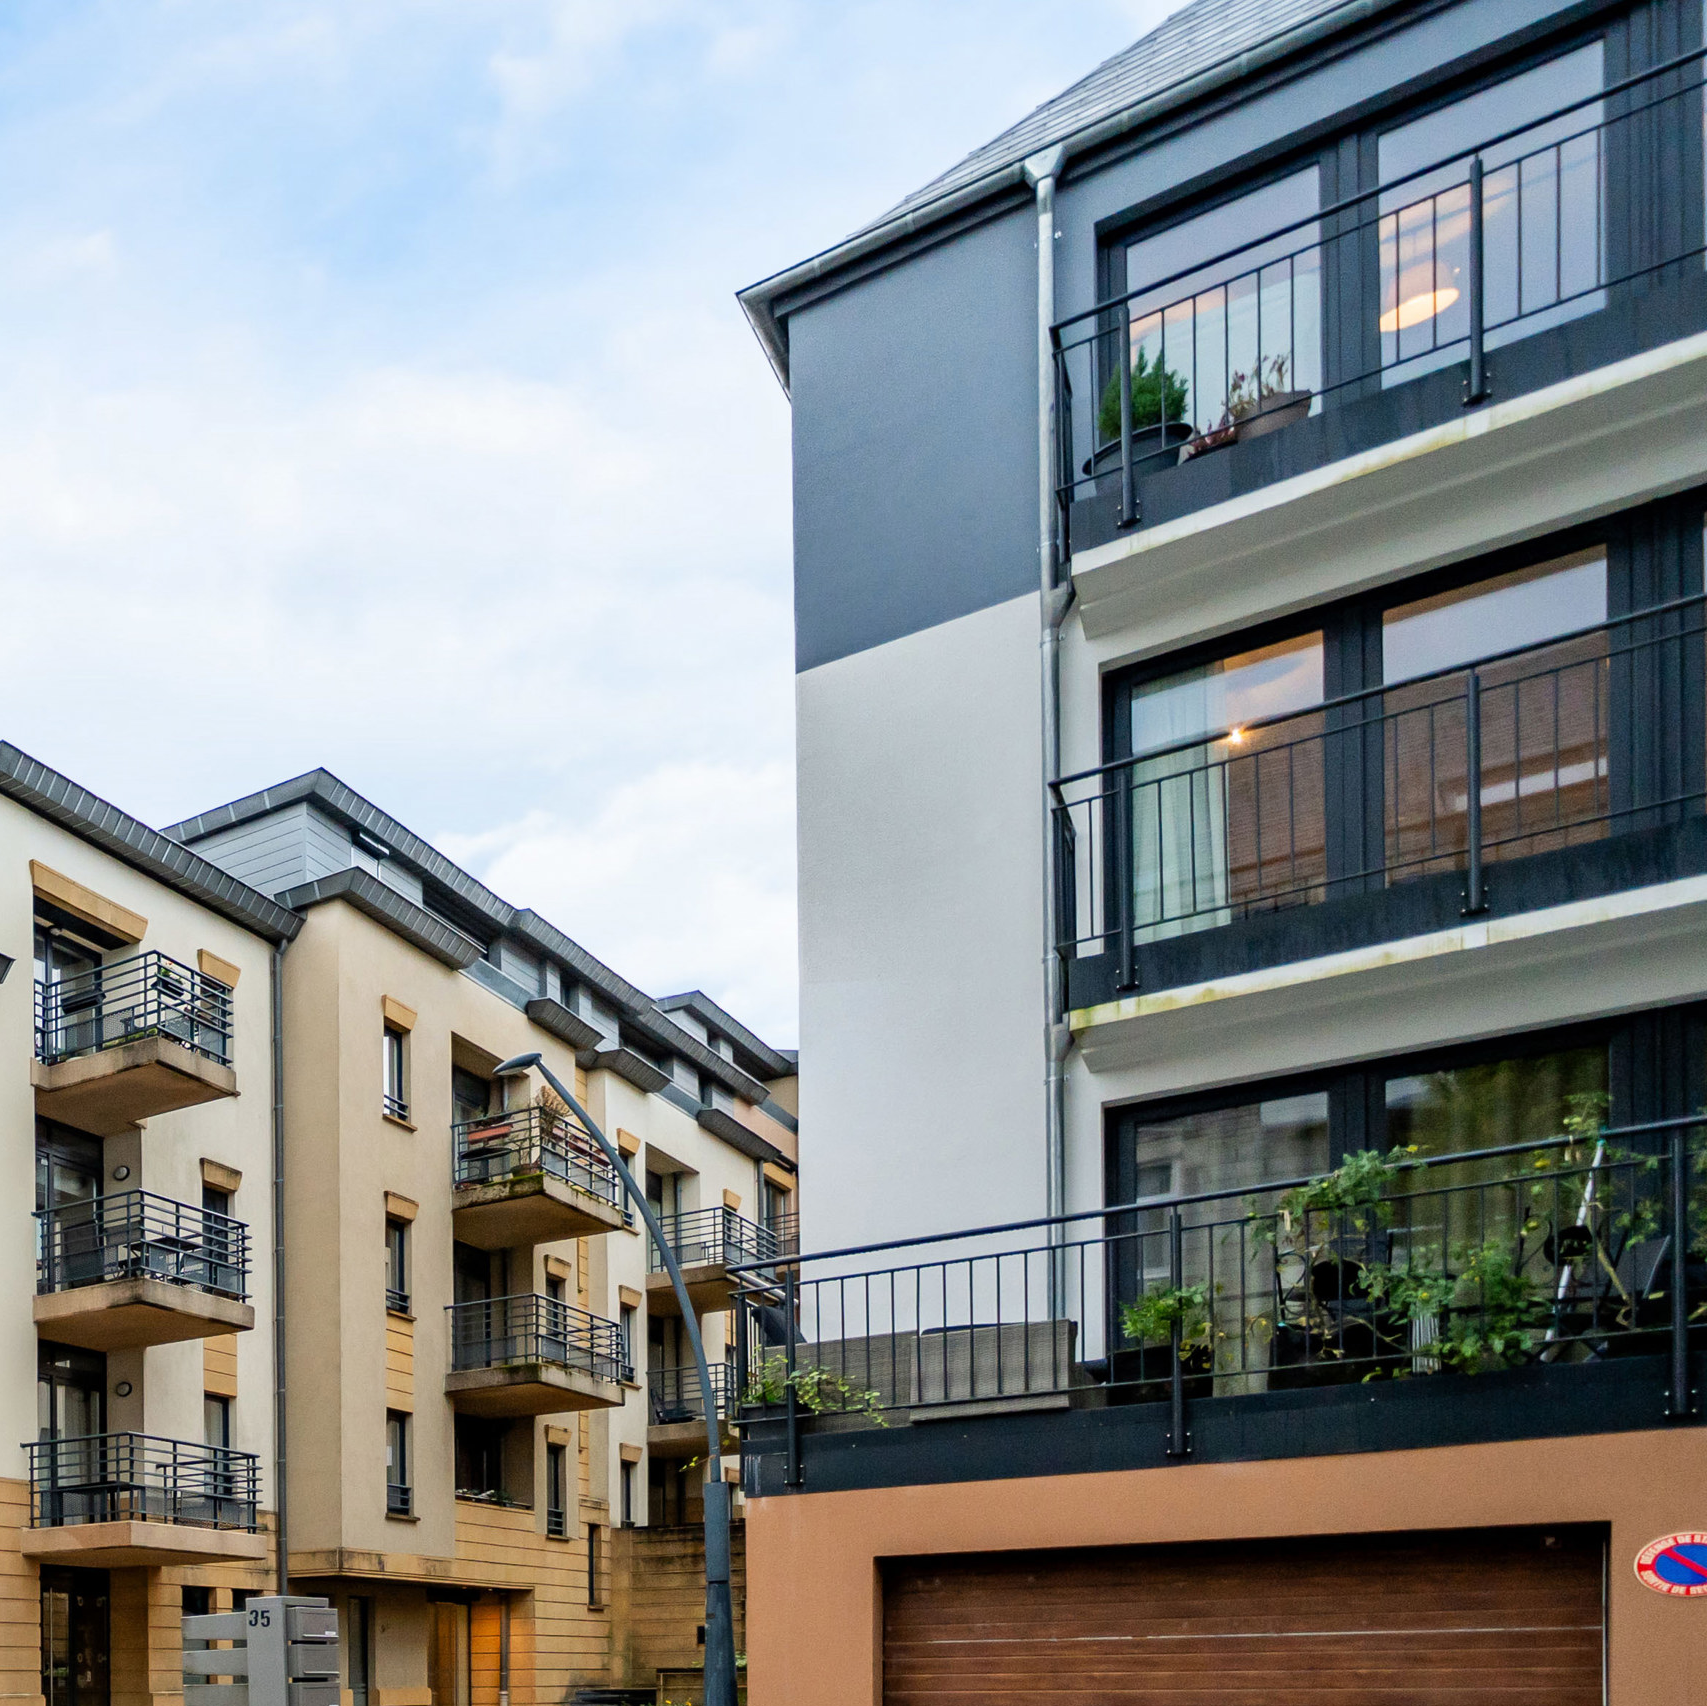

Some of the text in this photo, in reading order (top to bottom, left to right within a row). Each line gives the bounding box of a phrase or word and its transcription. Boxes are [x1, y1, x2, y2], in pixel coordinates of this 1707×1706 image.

[1677, 1535, 1692, 1544] DE
[1670, 1584, 1687, 1595] DE
[248, 1609, 271, 1628] 35
